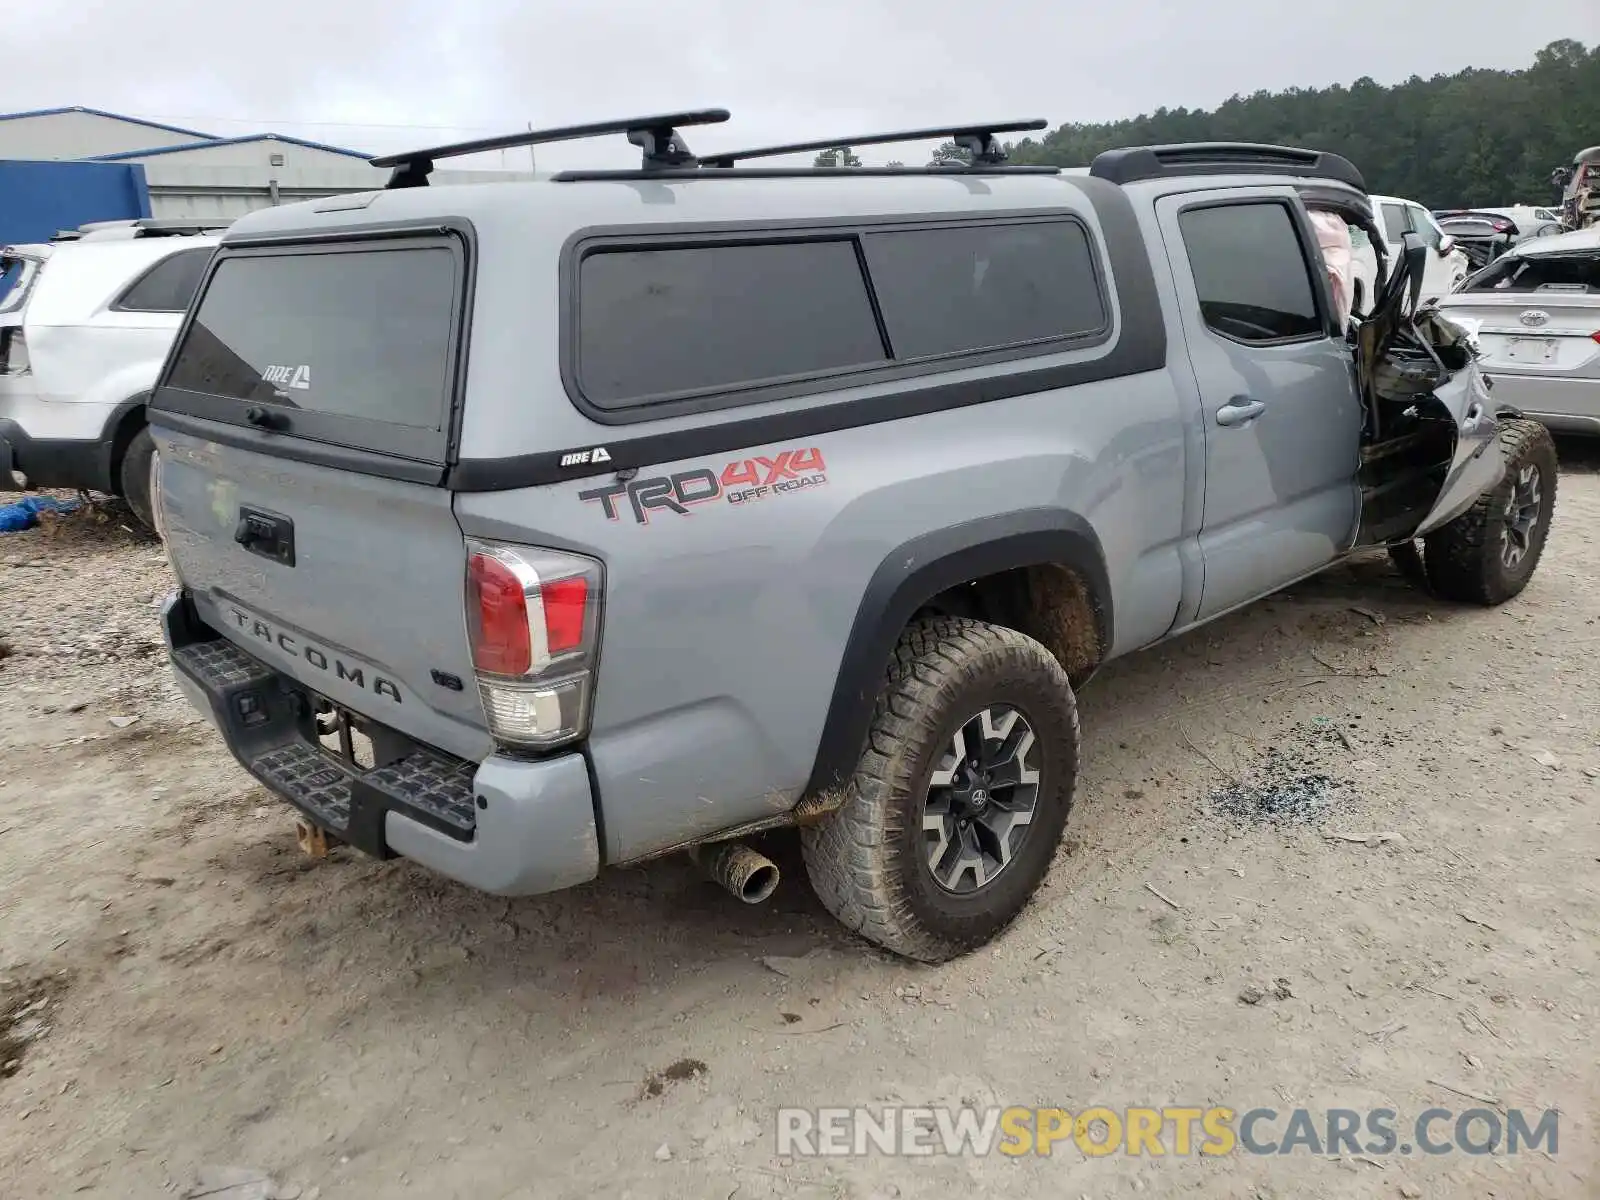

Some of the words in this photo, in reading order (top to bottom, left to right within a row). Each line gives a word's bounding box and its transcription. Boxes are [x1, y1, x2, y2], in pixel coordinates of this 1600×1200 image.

[579, 468, 723, 524] TRD
[727, 486, 768, 503] OFF
[772, 474, 826, 494] ROAD
[231, 607, 402, 704] TACOMA
